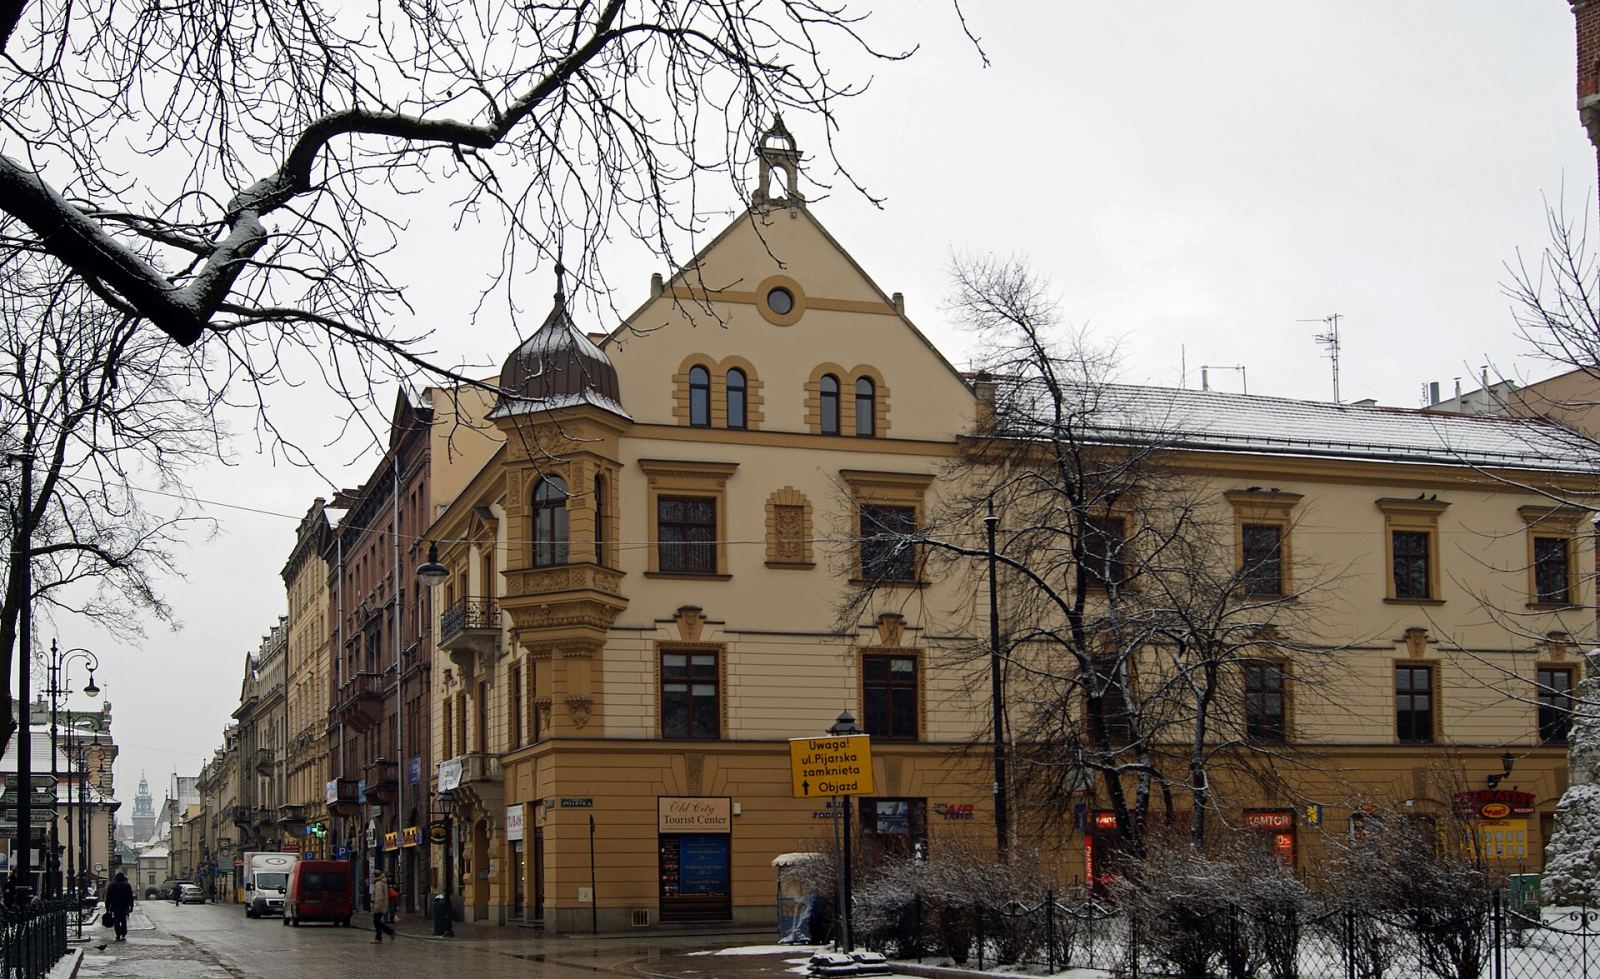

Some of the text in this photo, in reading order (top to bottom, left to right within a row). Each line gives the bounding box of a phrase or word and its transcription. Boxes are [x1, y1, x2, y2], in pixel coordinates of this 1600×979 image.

[809, 738, 850, 752] Uwaga!
[818, 780, 858, 794] Objazd
[670, 801, 716, 816] Old City
[665, 815, 728, 825] Tourist Center
